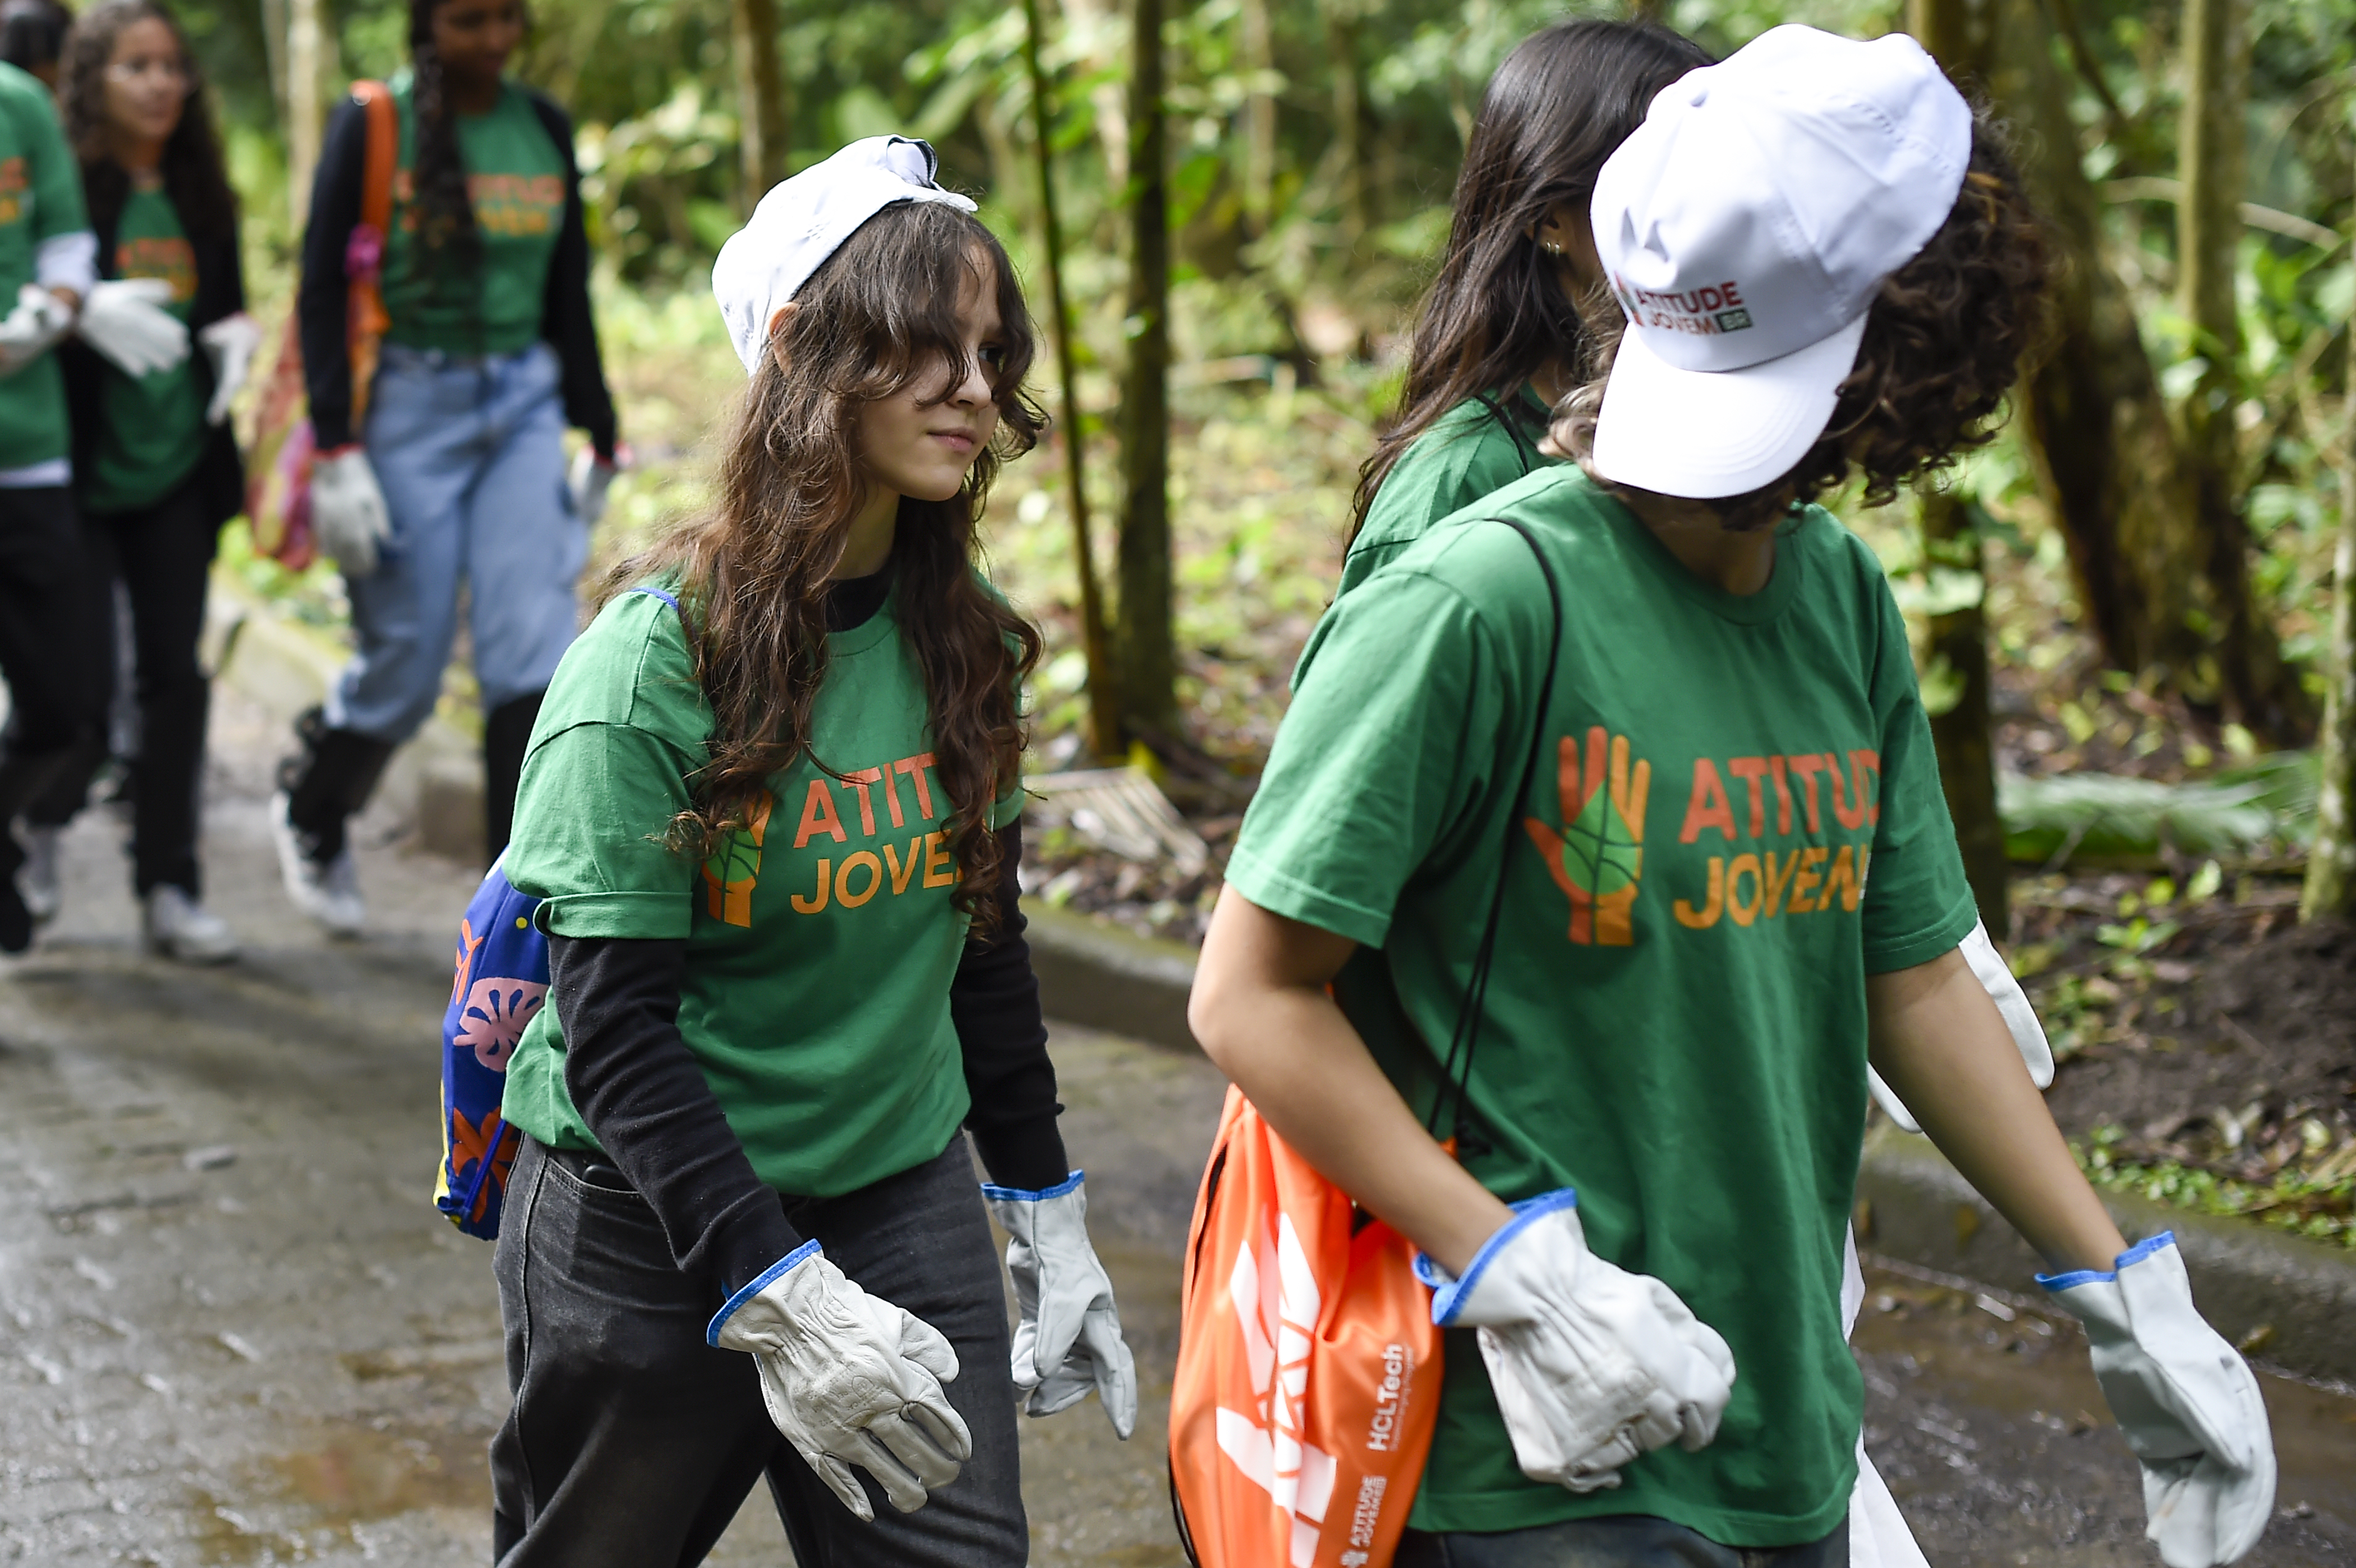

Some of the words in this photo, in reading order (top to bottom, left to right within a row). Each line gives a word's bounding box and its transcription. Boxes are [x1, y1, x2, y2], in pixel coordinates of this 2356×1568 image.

[1635, 282, 1742, 313] ATITUDE
[793, 751, 937, 849] ATIT
[1678, 748, 1880, 844] ATITUD
[790, 828, 964, 915] JOVE
[1366, 1342, 1403, 1451] HCLTech
